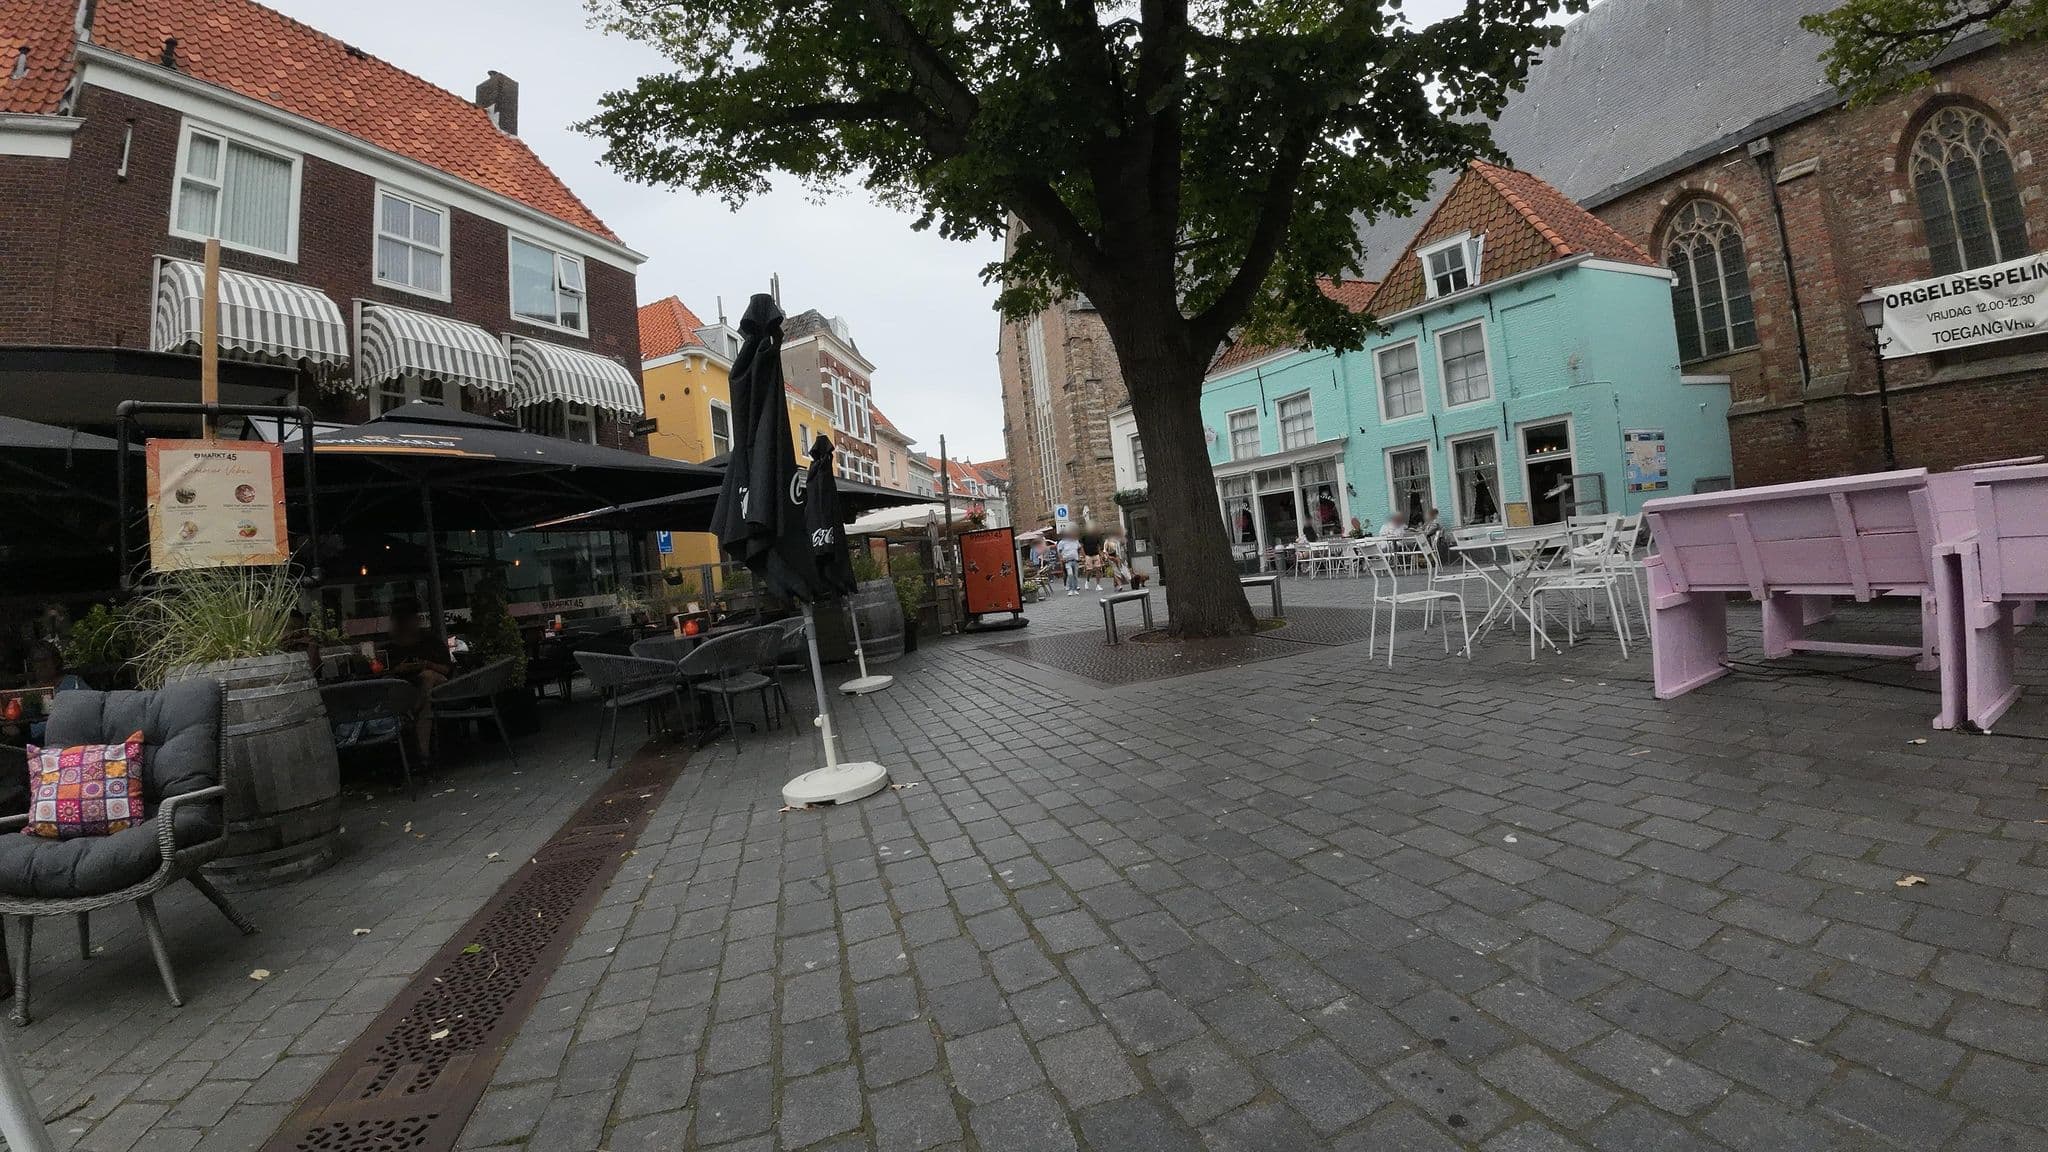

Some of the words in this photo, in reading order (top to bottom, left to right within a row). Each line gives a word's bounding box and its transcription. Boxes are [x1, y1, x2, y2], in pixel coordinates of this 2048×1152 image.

[1927, 306, 1972, 322] VRIJDAG
[1976, 294, 2035, 312] 12.00-12.30
[1932, 320, 2004, 343] TOEGANG
[227, 453, 237, 461] 45
